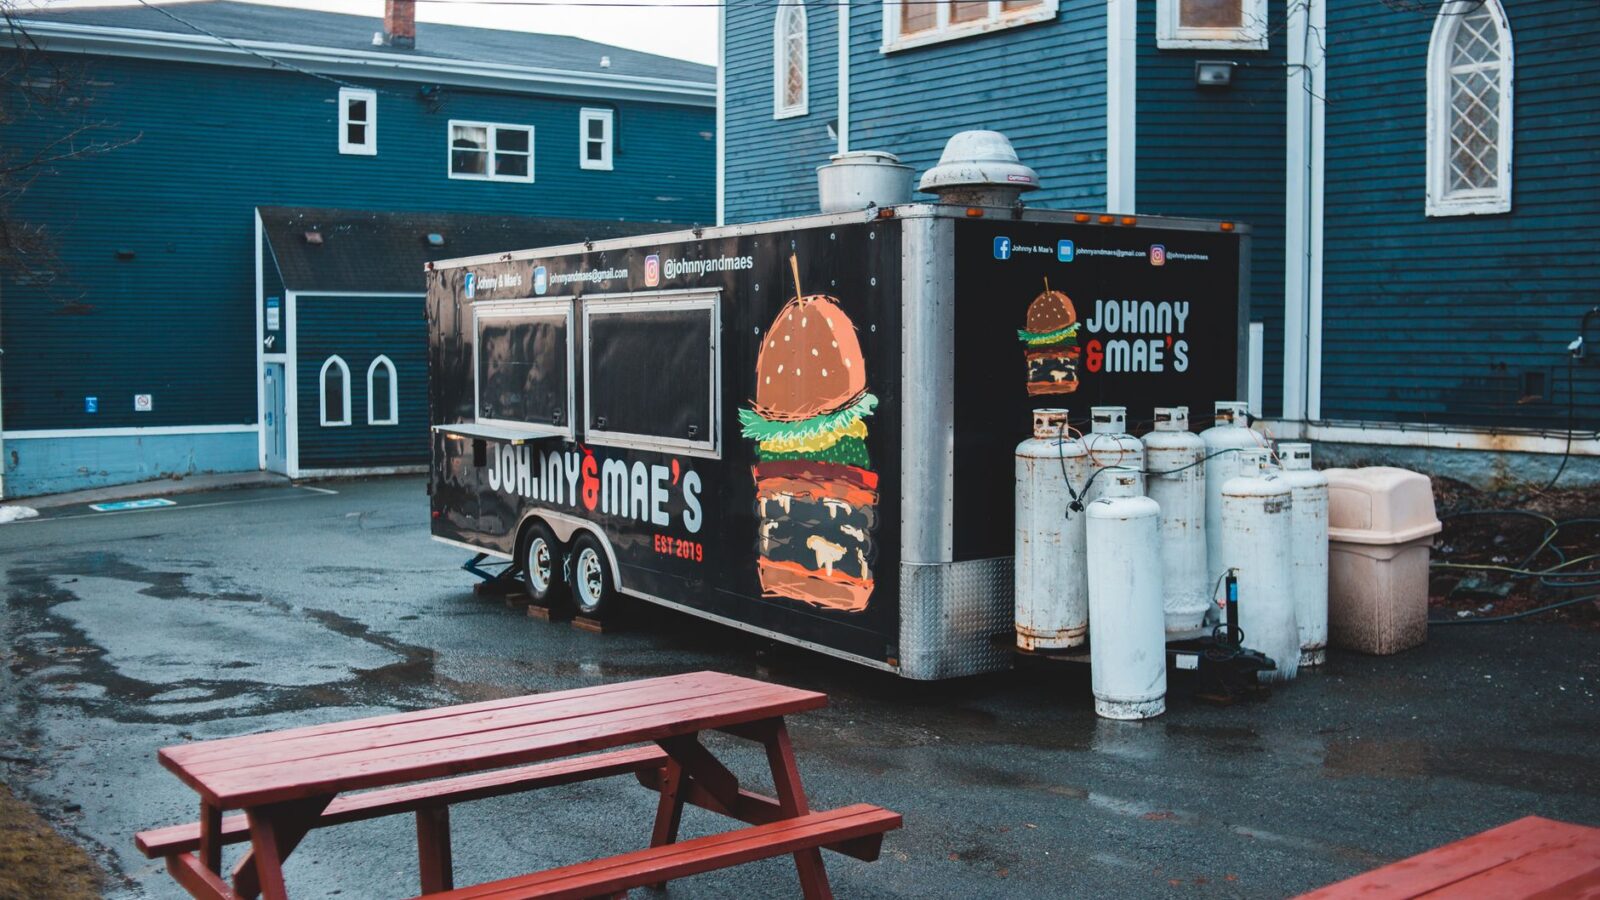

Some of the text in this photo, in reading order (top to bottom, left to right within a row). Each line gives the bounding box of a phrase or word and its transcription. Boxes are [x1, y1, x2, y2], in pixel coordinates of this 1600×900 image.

[1012, 244, 1032, 254] Johnny
[549, 267, 628, 286] johnnyandmaes@gmail.com
[664, 254, 753, 279] @johnnyandmaes
[477, 275, 498, 291] Johnny
[1086, 300, 1189, 333] JOHNNY
[654, 534, 702, 562] EST 2019
